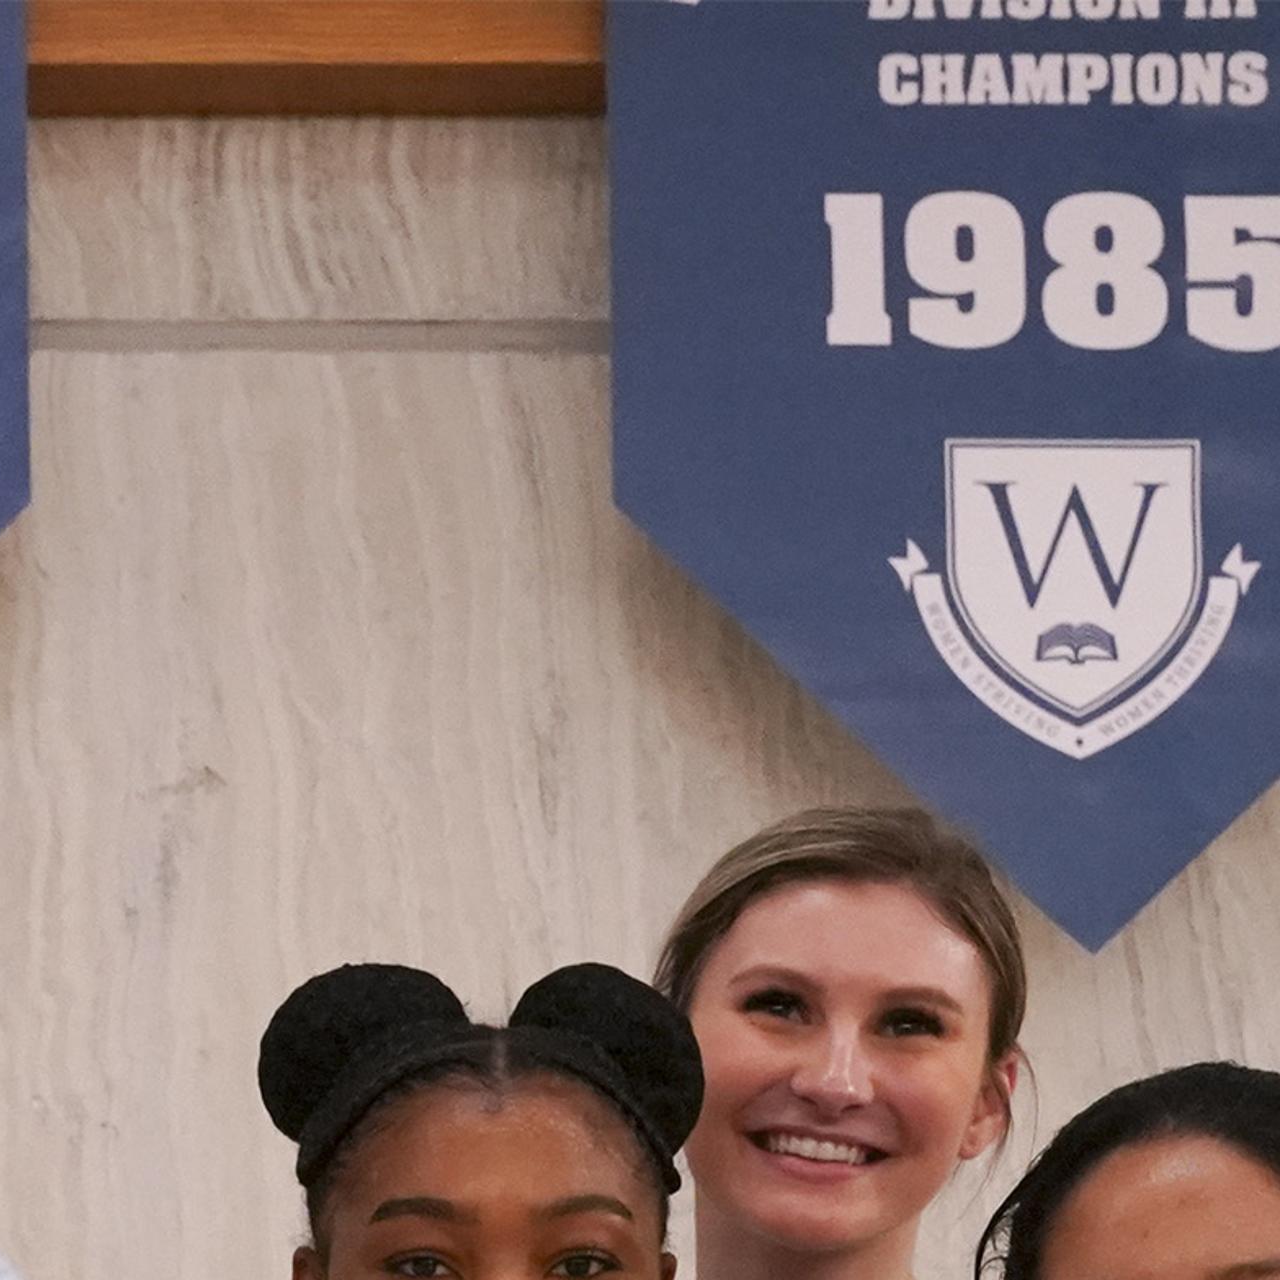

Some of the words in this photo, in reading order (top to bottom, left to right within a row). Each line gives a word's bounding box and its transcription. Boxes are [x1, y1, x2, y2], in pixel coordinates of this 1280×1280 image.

[877, 50, 1270, 107] CHAMPIONS
[823, 190, 1280, 353] 1985
[973, 482, 1169, 610] W
